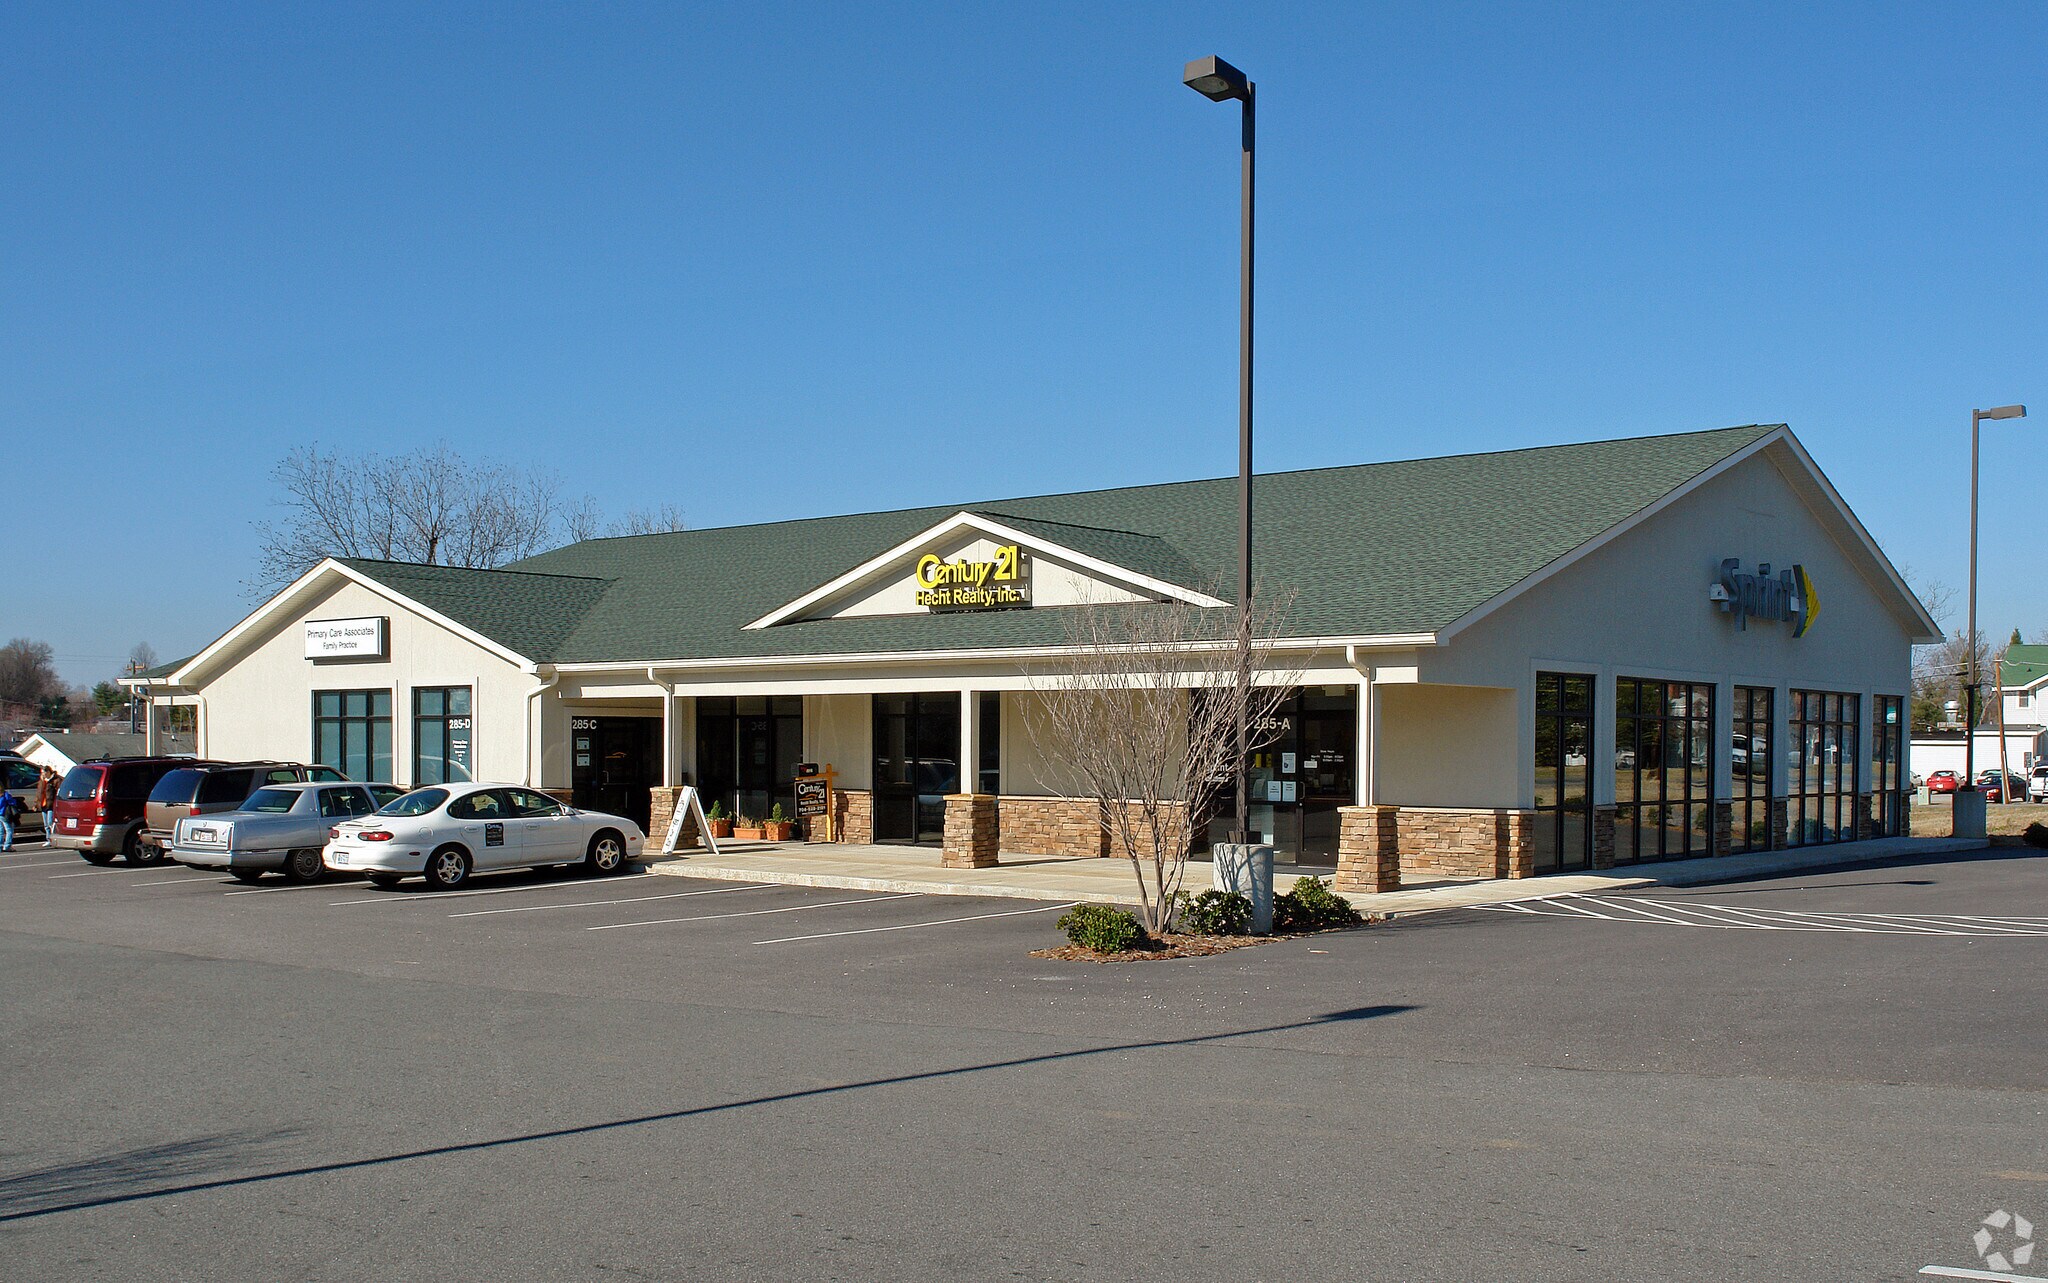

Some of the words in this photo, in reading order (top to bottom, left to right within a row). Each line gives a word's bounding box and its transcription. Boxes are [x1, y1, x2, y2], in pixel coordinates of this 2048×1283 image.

[916, 553, 992, 589] Century
[994, 546, 1019, 581] 21
[915, 589, 951, 606] Hecht
[953, 587, 995, 607] Realty,
[997, 586, 1020, 603] Inc.
[1720, 557, 1795, 631] Sprint
[307, 629, 328, 640] Primary
[329, 628, 343, 638] Care
[344, 627, 375, 637] Associates
[323, 642, 338, 651] Family
[339, 641, 358, 649] Practice
[448, 718, 471, 730] 285-D
[1253, 717, 1291, 730] 285-A
[798, 784, 820, 794] Century
[818, 789, 825, 798] 21
